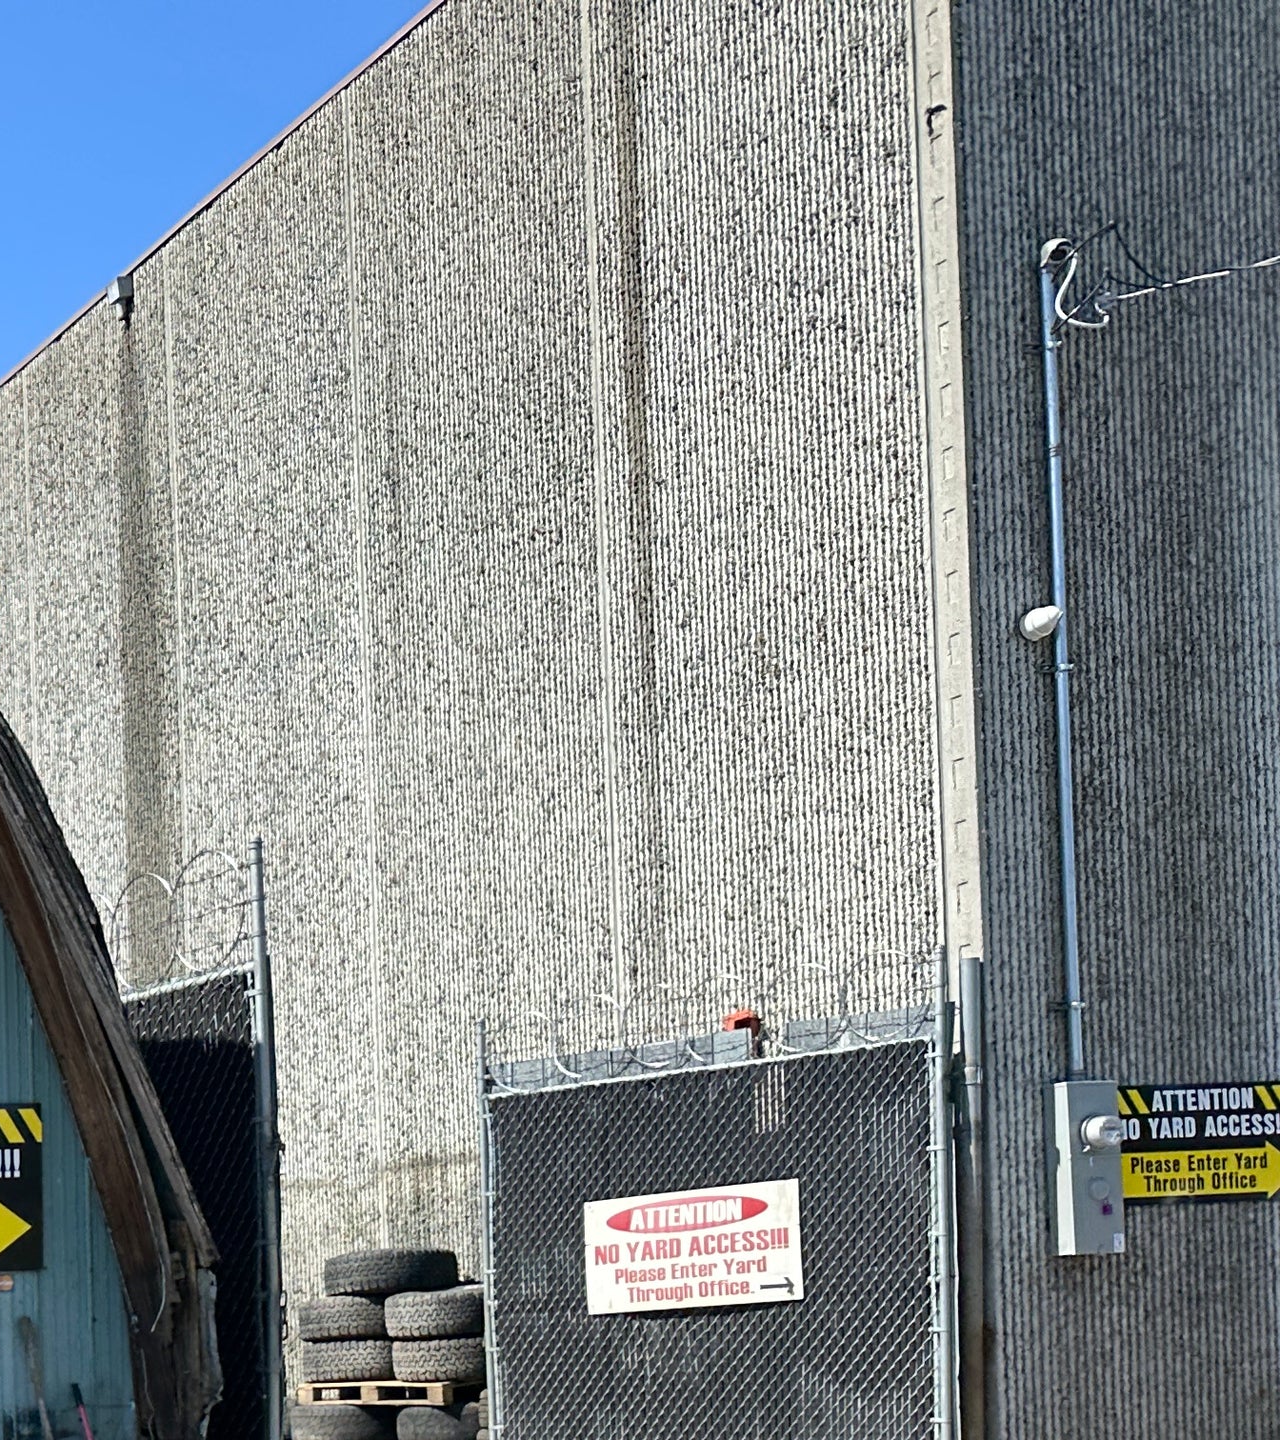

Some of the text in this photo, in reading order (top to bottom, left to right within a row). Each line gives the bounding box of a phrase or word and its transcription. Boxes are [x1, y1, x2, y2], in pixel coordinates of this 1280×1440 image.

[1151, 1087, 1254, 1112] ATTENTION
[1148, 1116, 1197, 1139] YARD
[1130, 1152, 1268, 1174] Please Enter Yard
[1143, 1173, 1257, 1193] Through Office
[629, 1197, 743, 1232] ATTENTION
[594, 1227, 790, 1265] NO YARD ACCESS!!!
[614, 1256, 768, 1284] Please Enter Yard
[627, 1283, 694, 1303] Through
